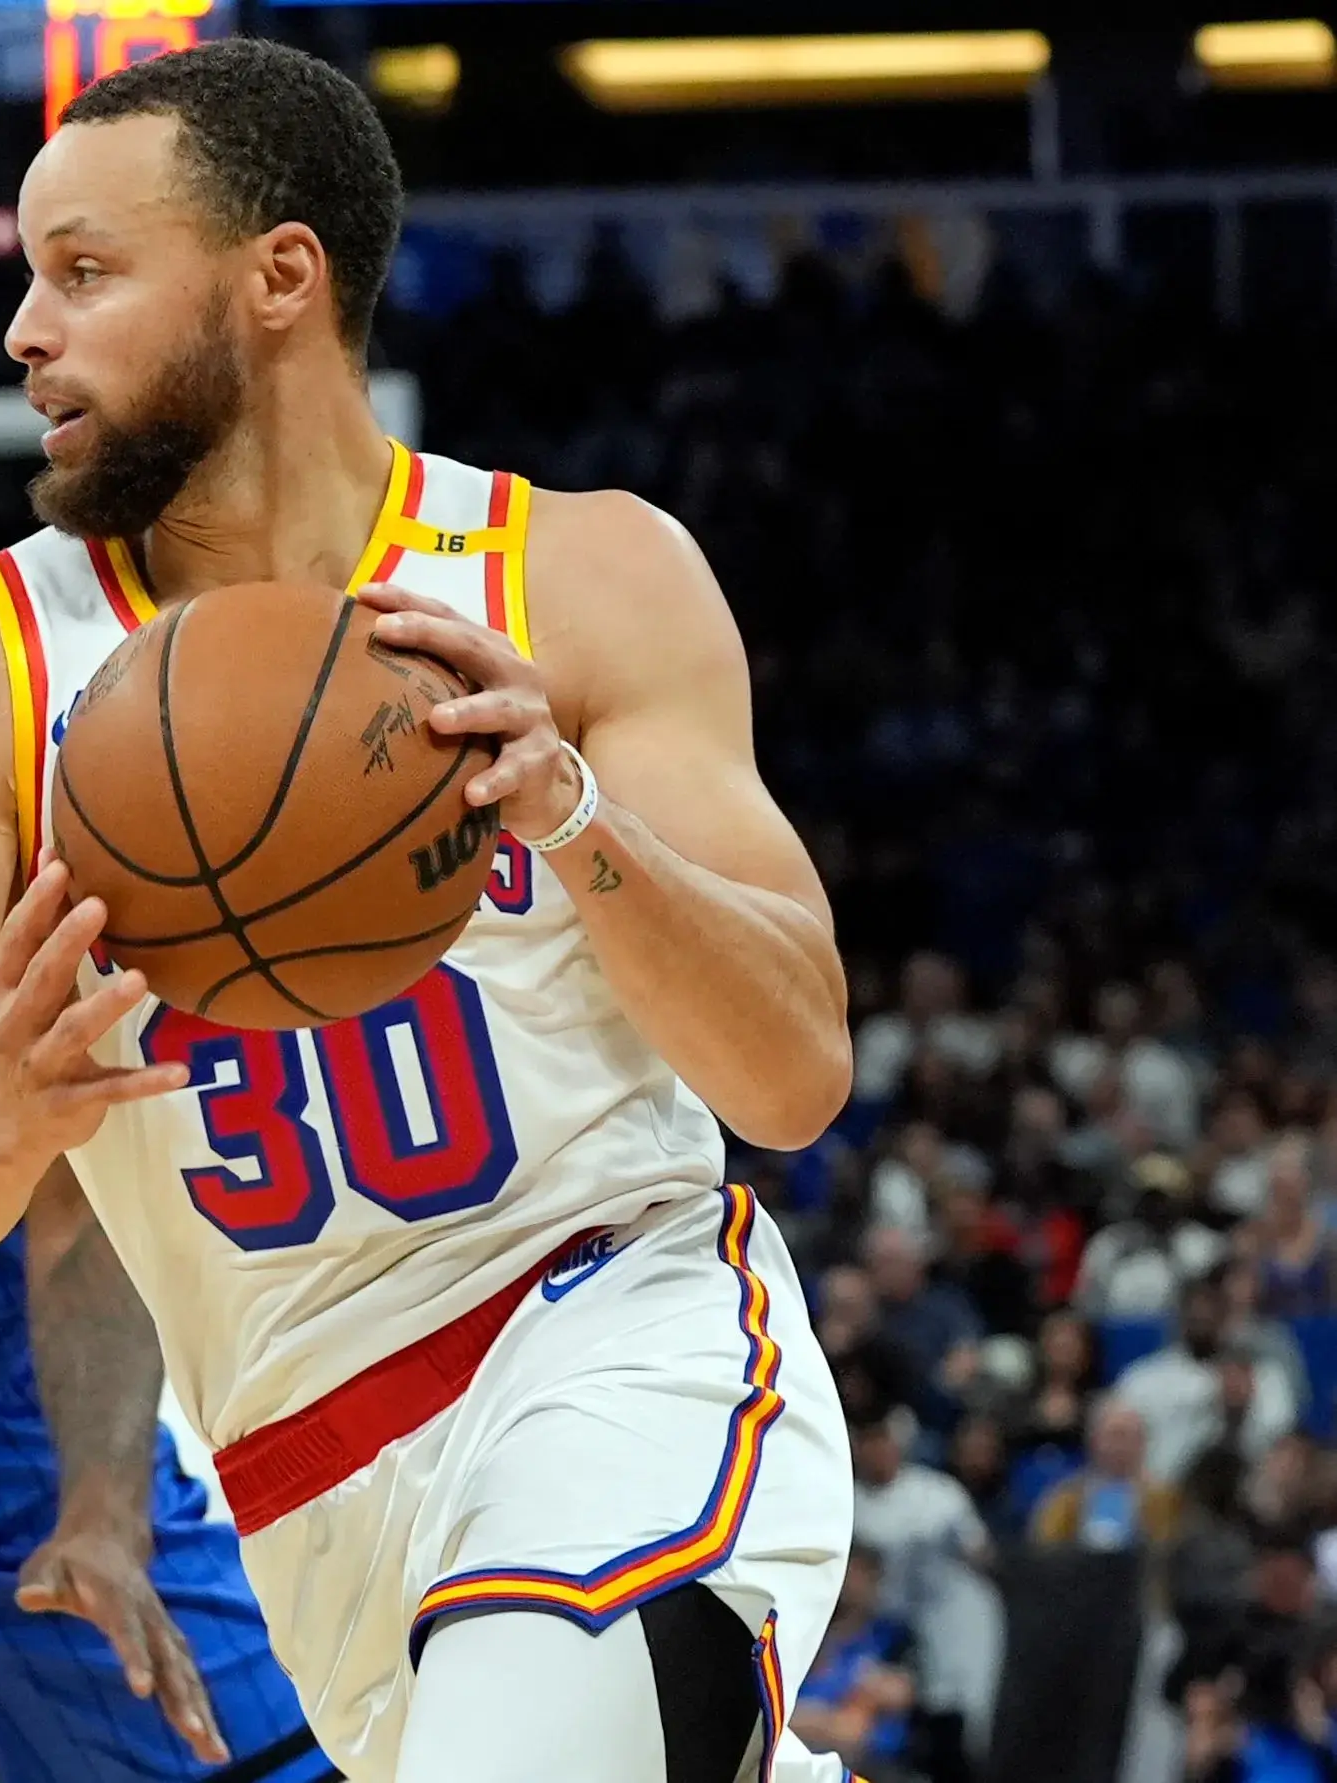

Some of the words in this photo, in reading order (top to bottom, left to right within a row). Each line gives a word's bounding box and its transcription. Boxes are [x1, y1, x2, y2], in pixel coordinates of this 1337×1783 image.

[434, 532, 466, 553] 16
[139, 956, 518, 1253] 30
[549, 1231, 615, 1280] NIKE
